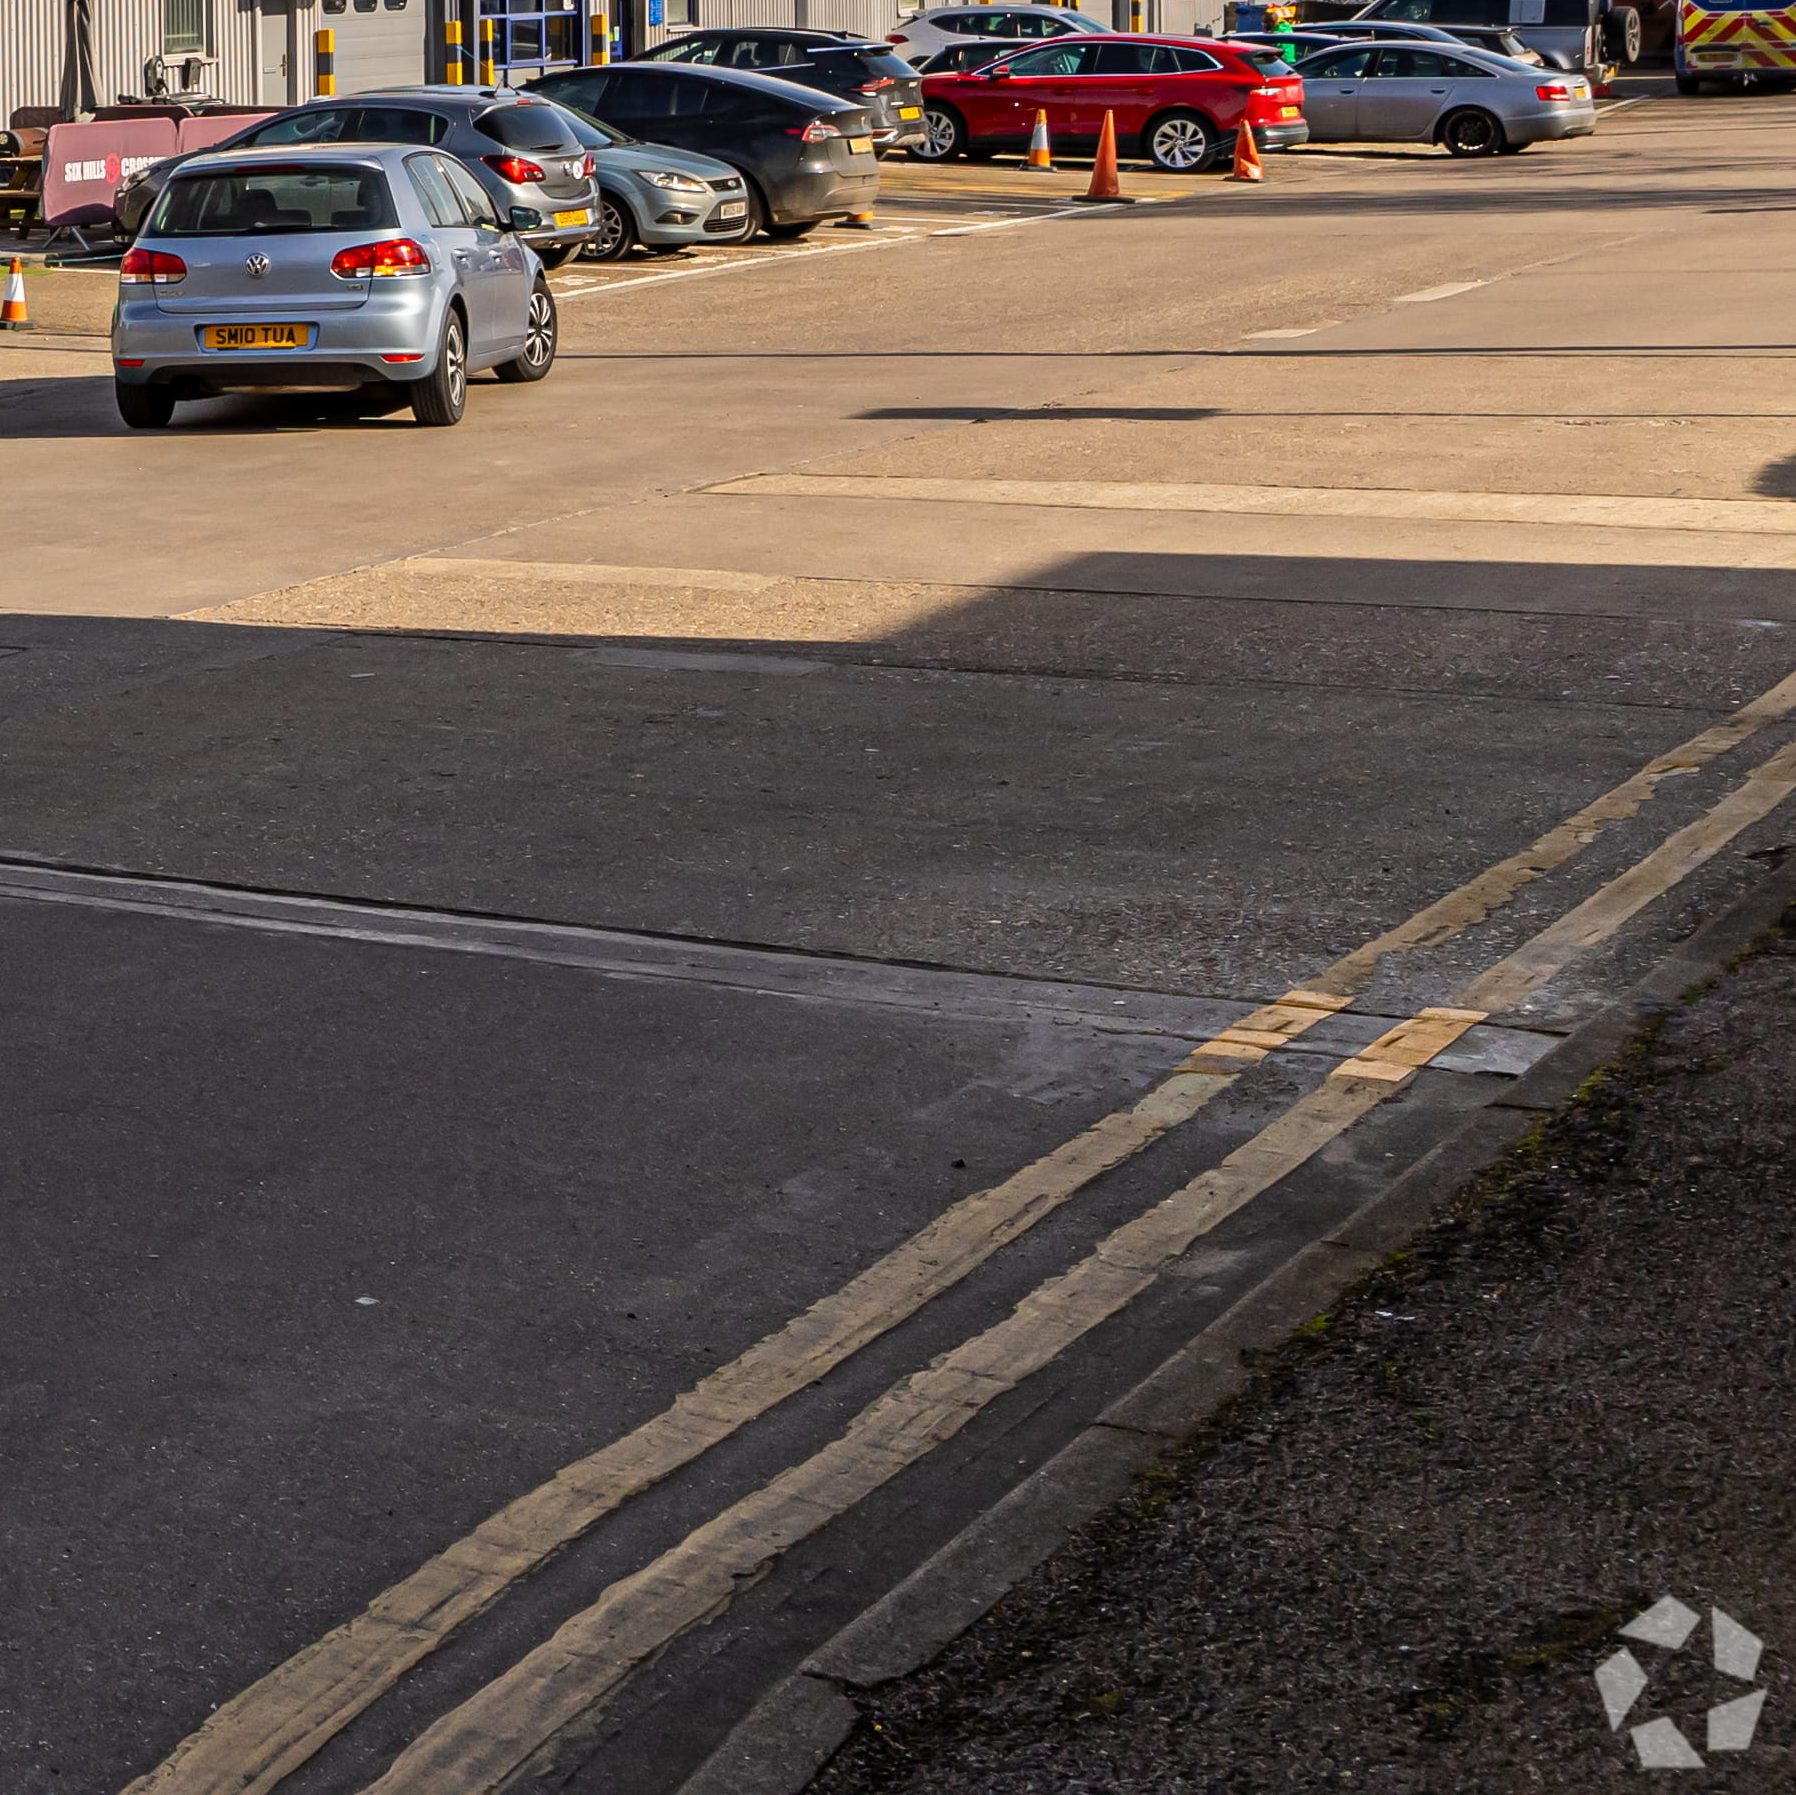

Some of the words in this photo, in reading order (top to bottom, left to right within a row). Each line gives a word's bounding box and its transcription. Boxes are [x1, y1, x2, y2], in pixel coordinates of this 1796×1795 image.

[65, 161, 83, 183] SIX
[82, 159, 106, 181] HILLS
[261, 327, 297, 344] TUA
